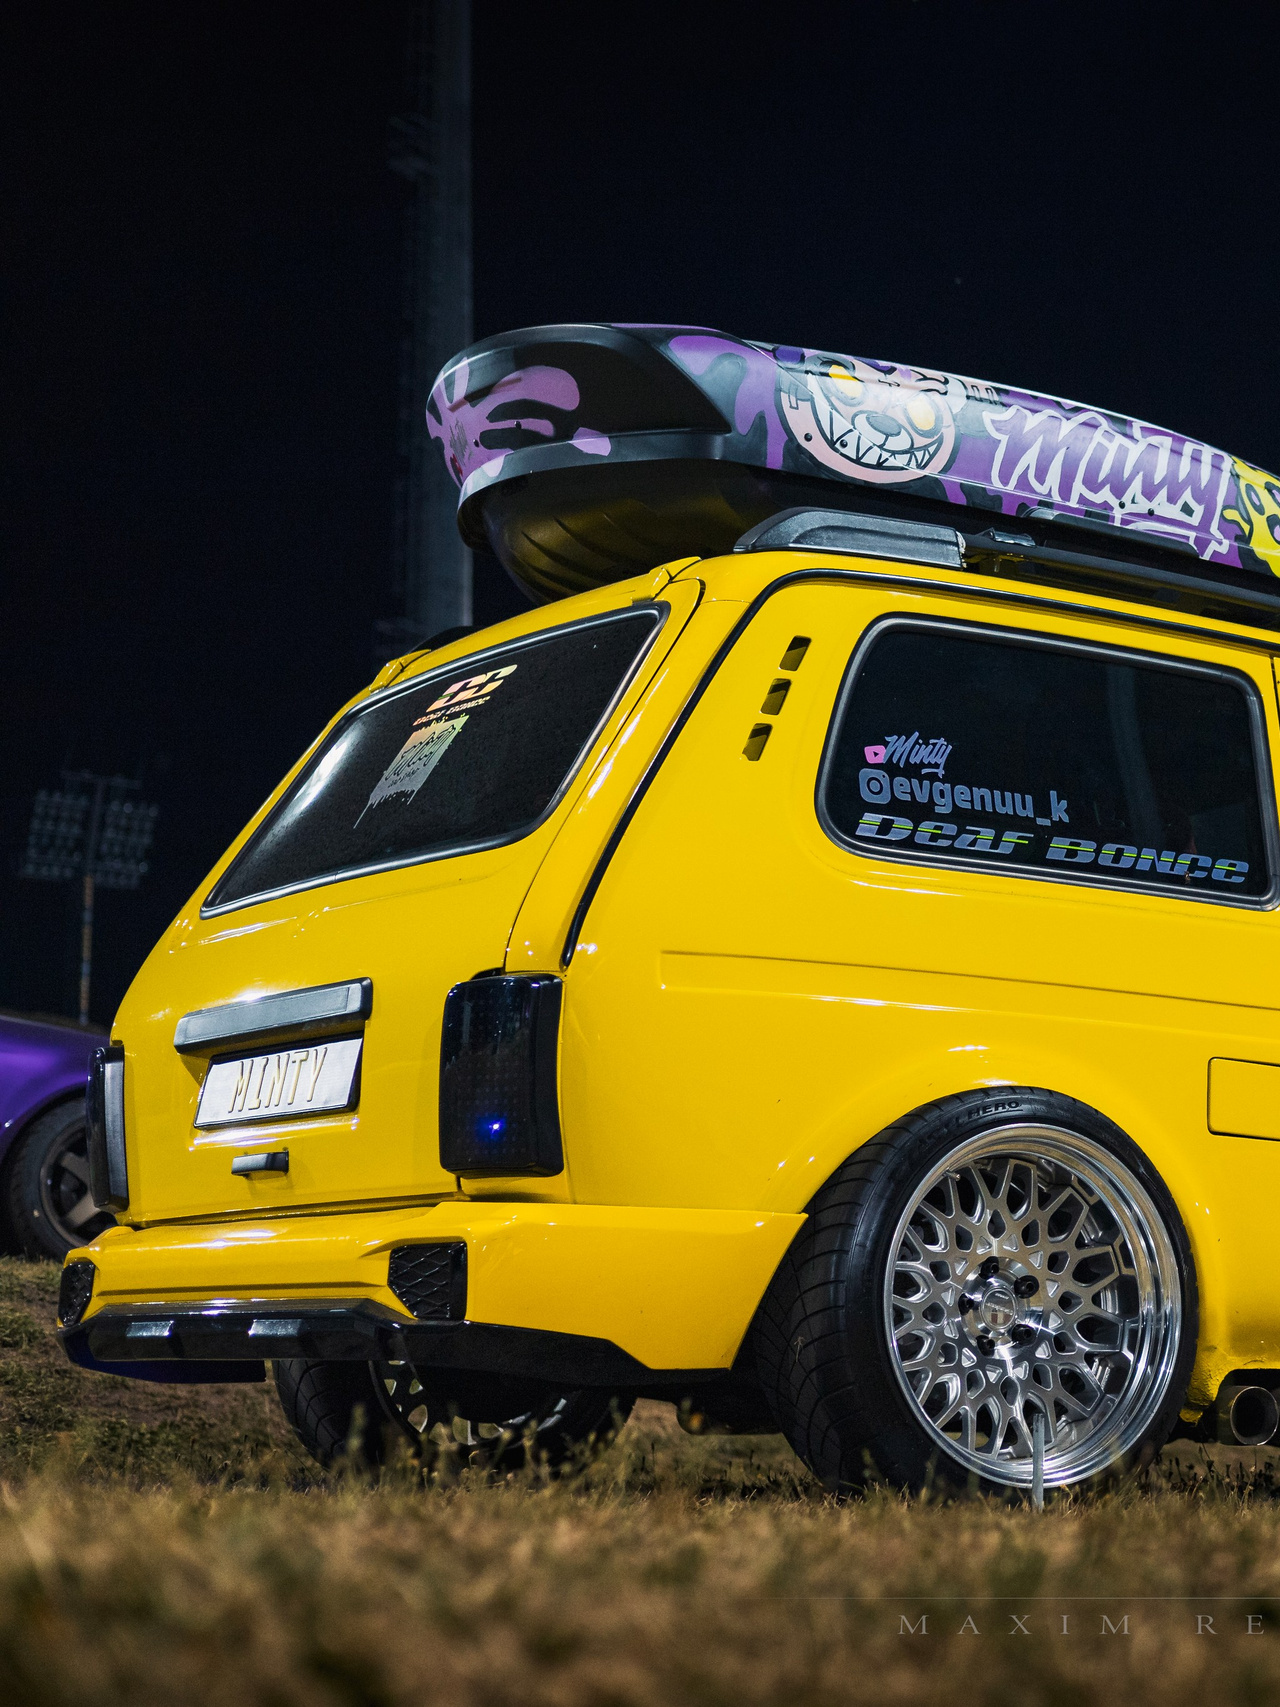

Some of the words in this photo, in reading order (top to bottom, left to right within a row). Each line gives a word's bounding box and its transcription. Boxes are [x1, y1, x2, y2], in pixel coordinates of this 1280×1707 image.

[884, 731, 953, 778] Minty
[893, 776, 1070, 826] evgenuu_k
[228, 1047, 328, 1114] MINTY
